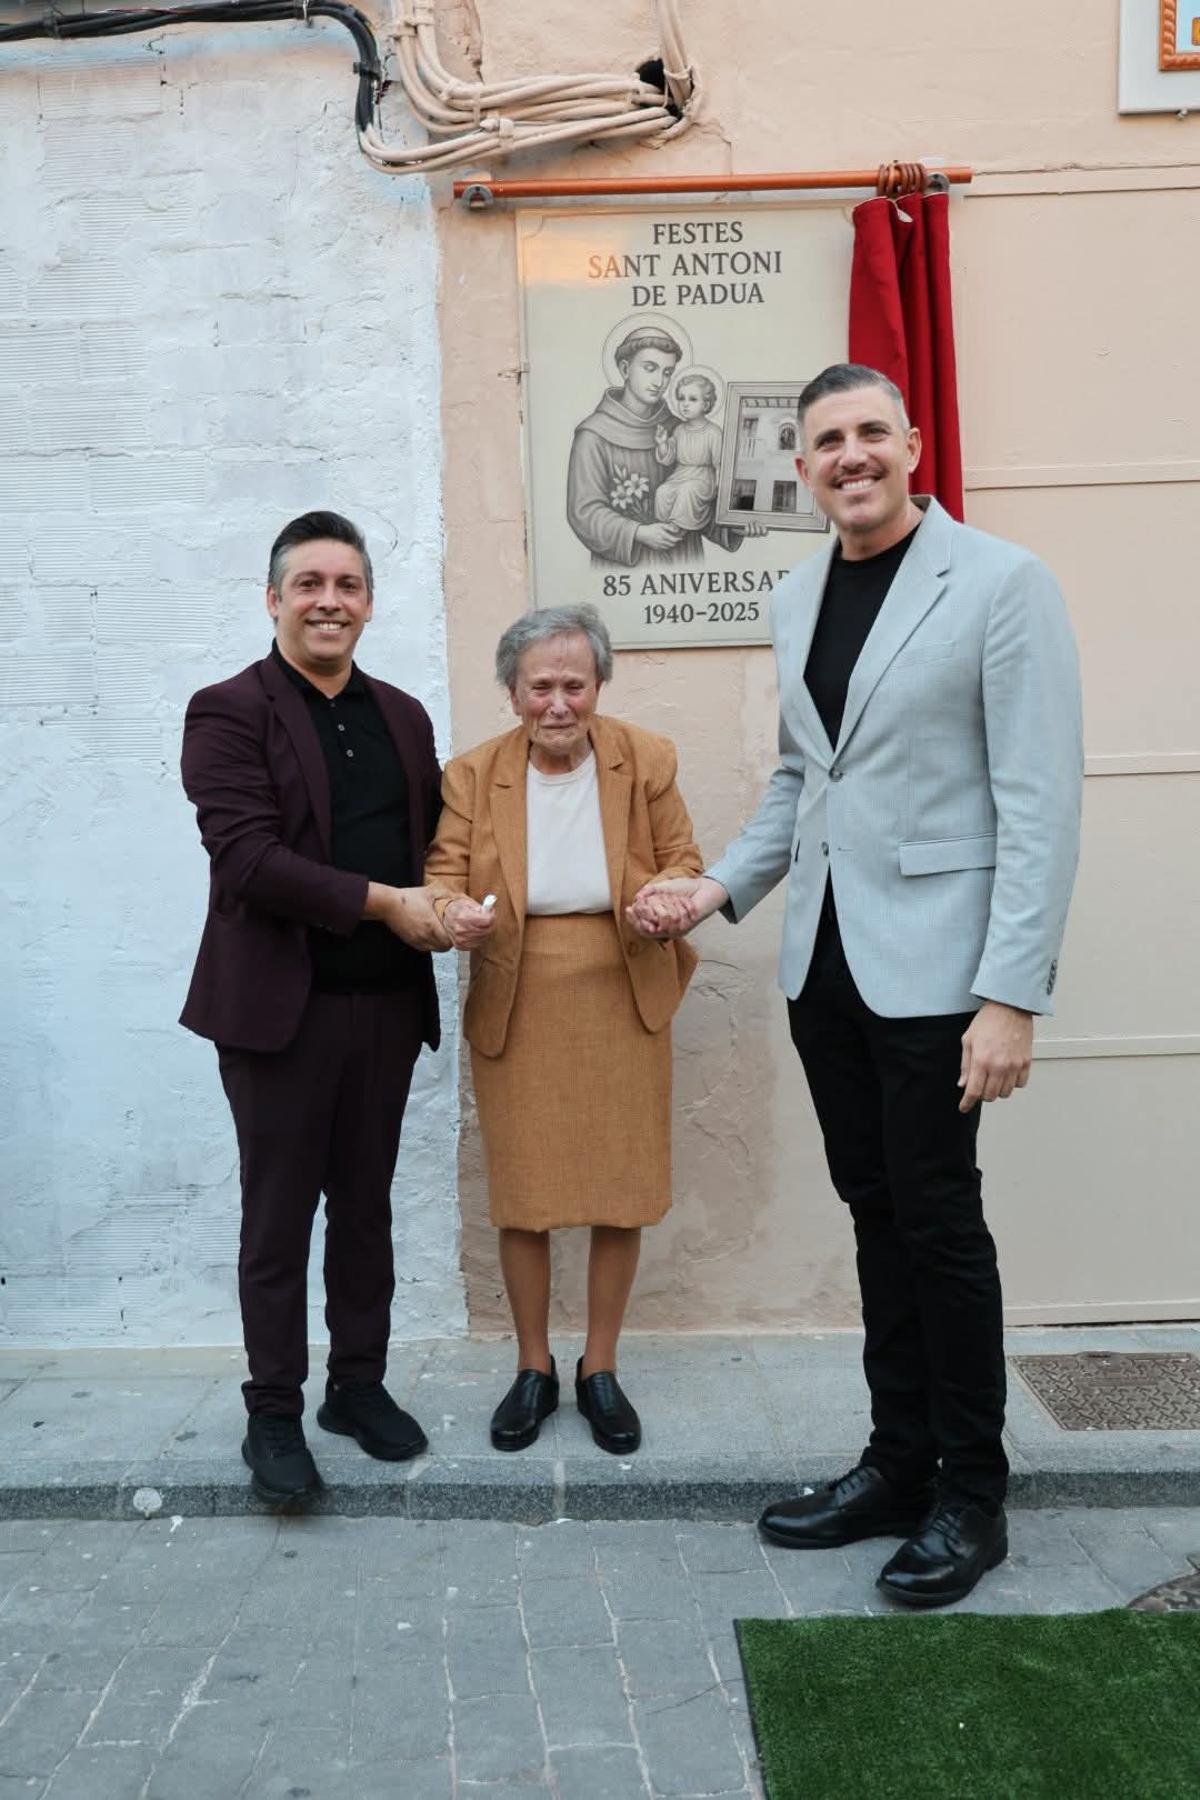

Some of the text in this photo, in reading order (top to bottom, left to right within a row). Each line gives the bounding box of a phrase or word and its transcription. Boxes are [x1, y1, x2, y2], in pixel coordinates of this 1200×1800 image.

[653, 221, 743, 245] FESTES
[588, 250, 782, 279] SANT ANTONI
[632, 282, 765, 307] DE PADUA
[603, 575, 631, 596] 85
